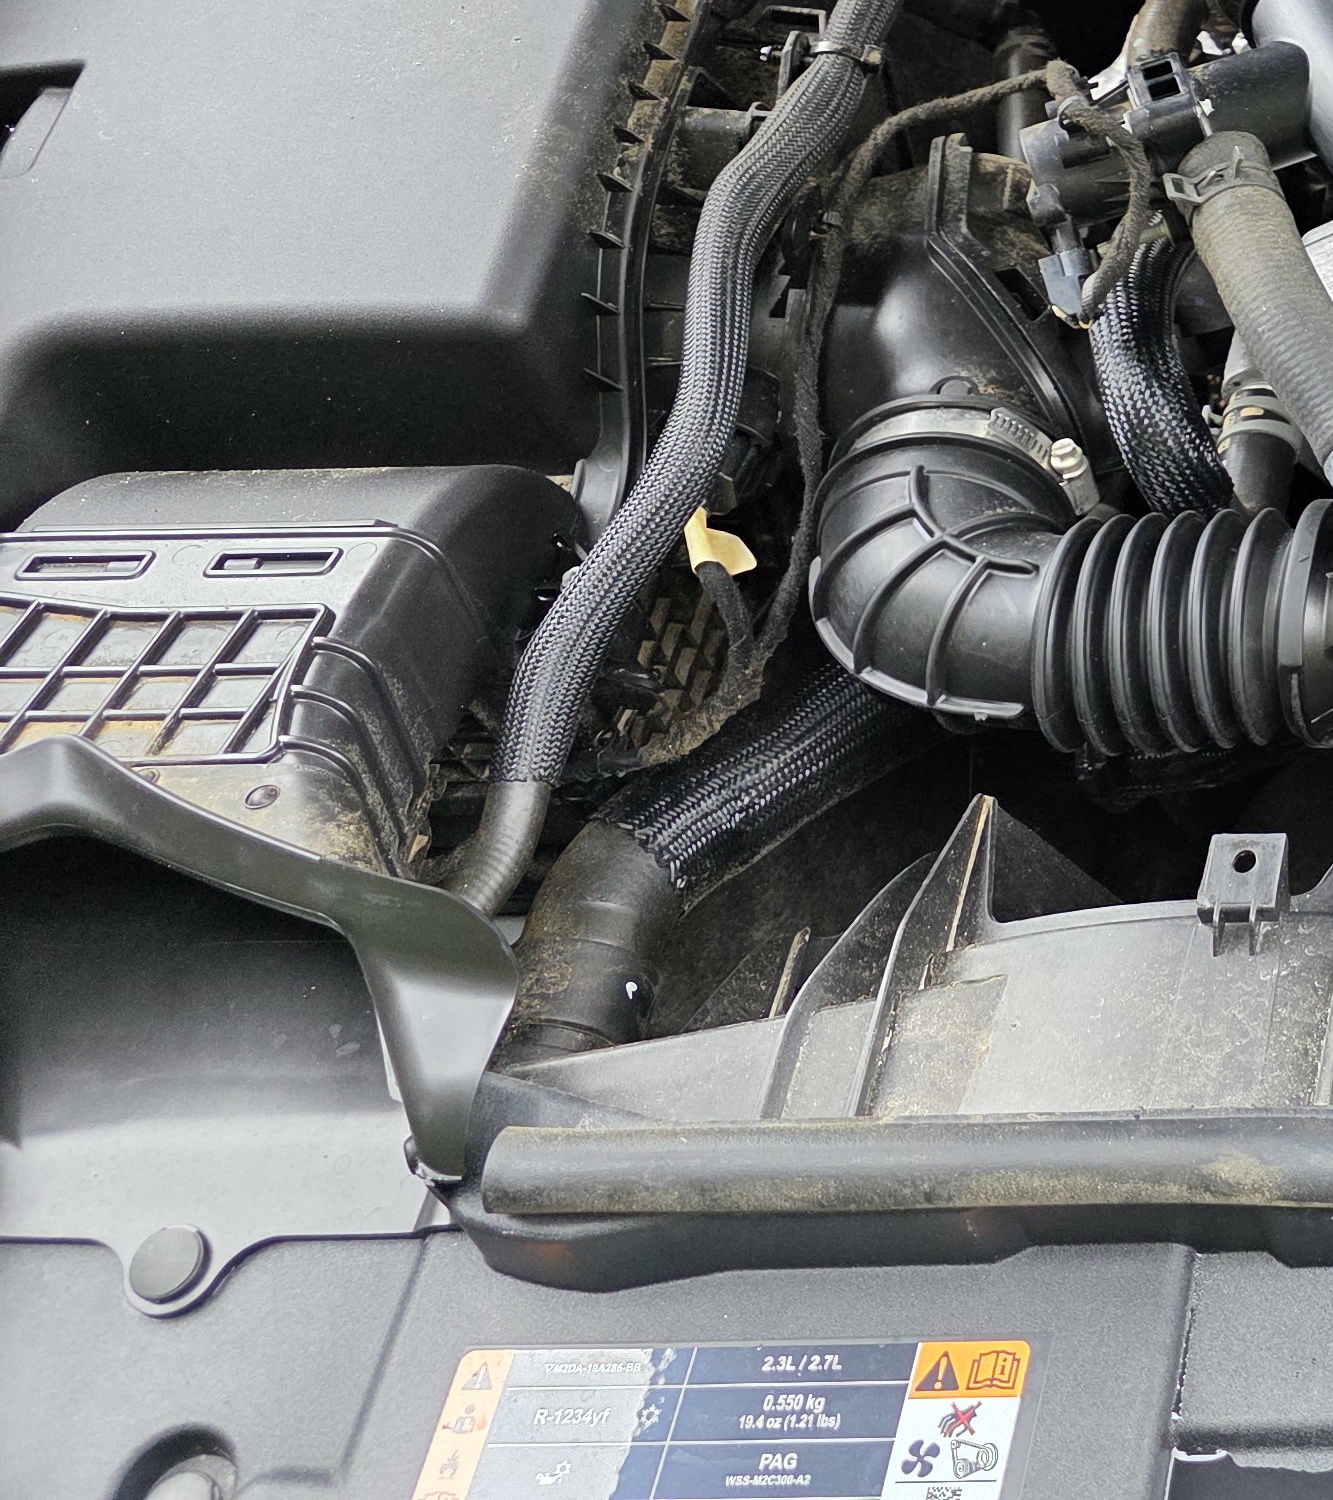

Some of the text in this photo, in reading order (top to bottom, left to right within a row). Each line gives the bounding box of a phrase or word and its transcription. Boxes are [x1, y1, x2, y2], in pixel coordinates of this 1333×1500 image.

[762, 1355, 796, 1371] 2.3L
[808, 1354, 842, 1371] 2.7L
[533, 1393, 825, 1427] R-1234yf 0.550 kg
[738, 1413, 841, 1431] 19.4 oz (1.21 lbs)
[758, 1452, 799, 1470] PAG
